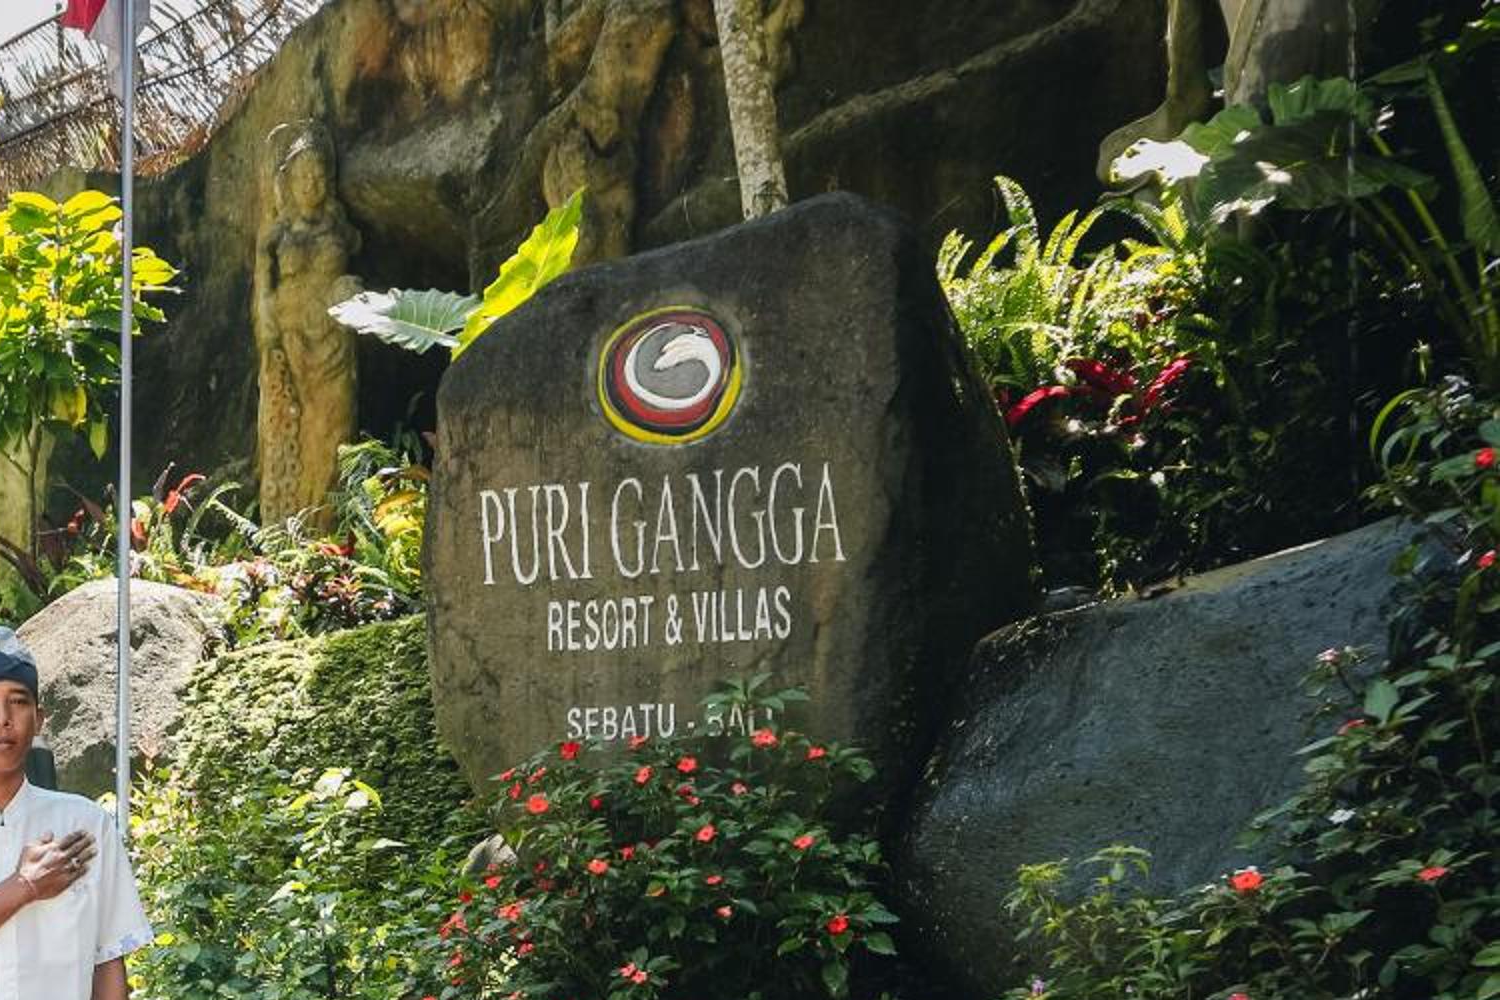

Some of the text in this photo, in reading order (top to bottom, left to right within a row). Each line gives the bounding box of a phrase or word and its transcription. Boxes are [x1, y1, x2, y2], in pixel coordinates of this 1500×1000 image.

[479, 461, 846, 585] PURI GANGGA
[548, 585, 791, 651] RESORT & VILLAS
[567, 703, 675, 741] SEBATU
